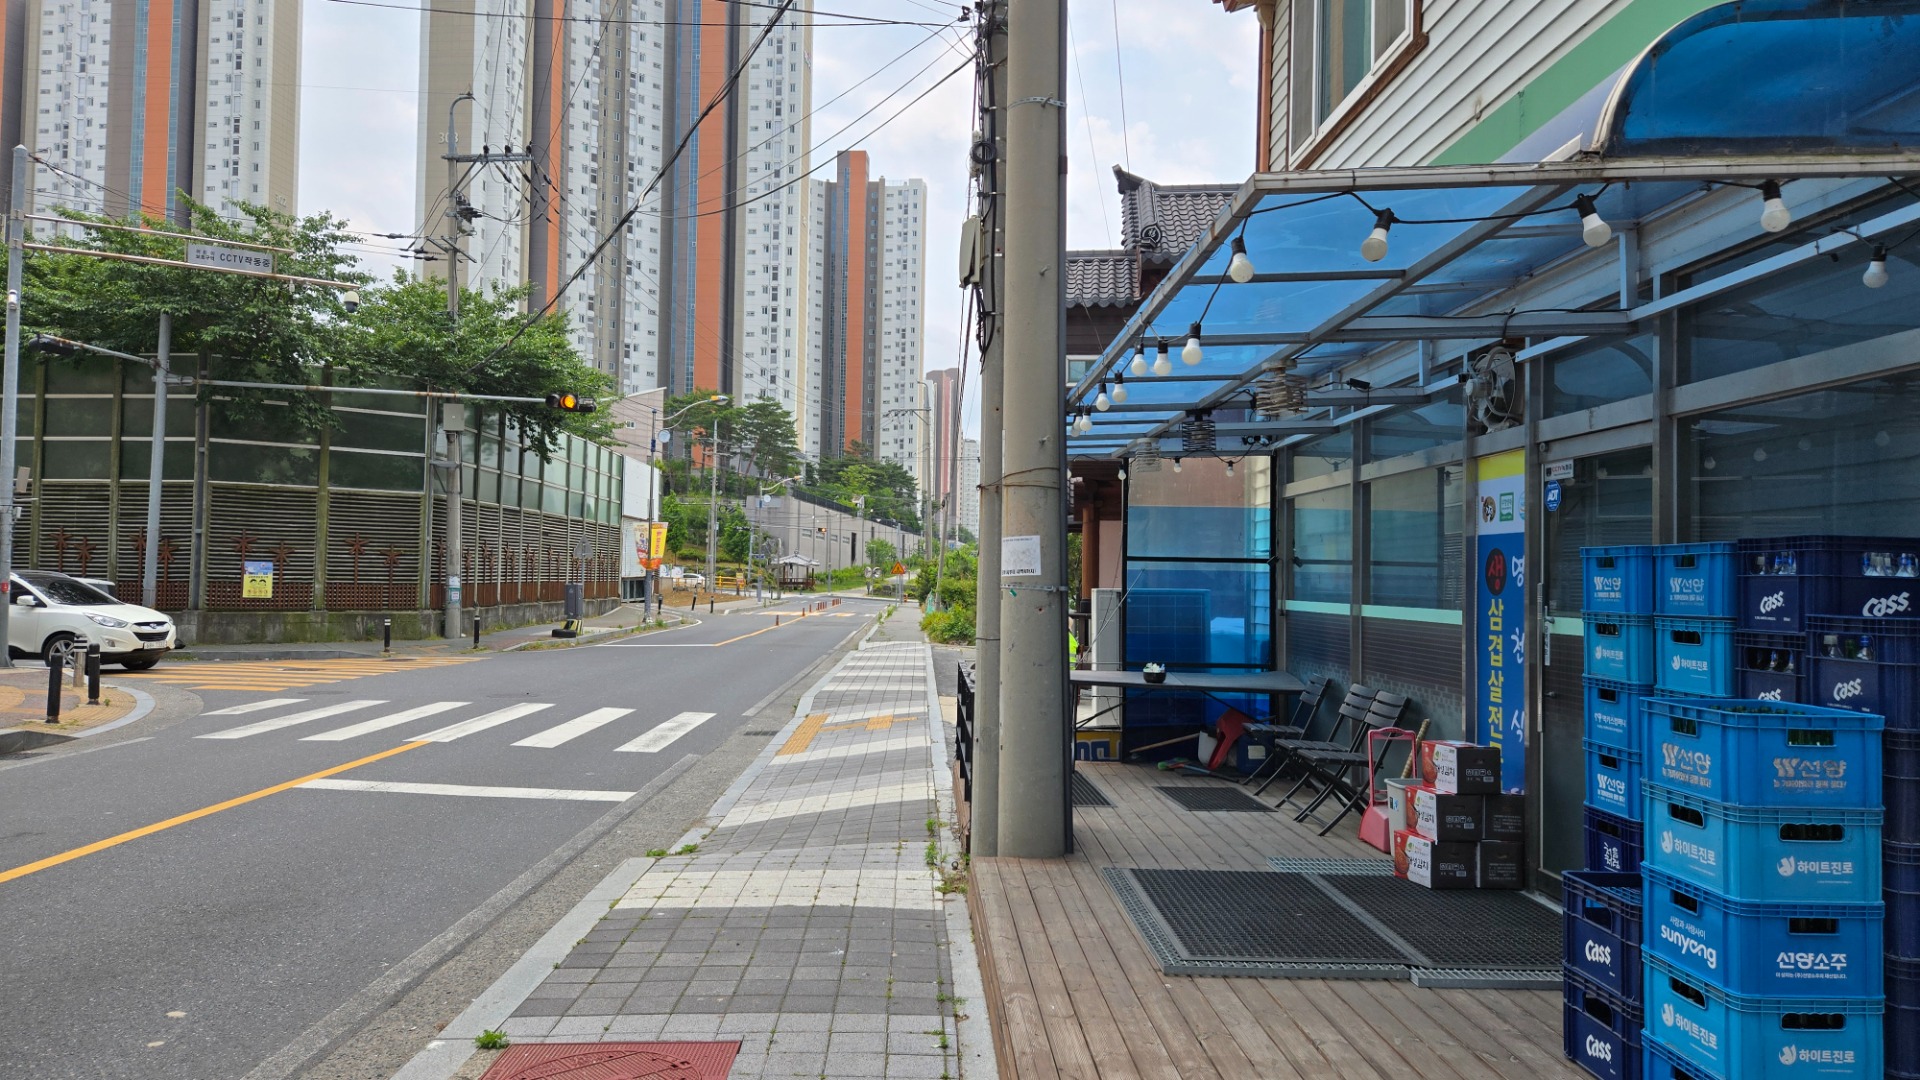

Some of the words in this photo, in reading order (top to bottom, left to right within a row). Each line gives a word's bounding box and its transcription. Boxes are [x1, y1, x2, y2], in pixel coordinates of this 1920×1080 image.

[219, 252, 271, 268] CCTV작동중
[1759, 590, 1784, 614] Cass
[1862, 591, 1912, 617] Cass
[1602, 648, 1624, 660] 하이트진로
[1681, 658, 1708, 671] 하이트진로
[1833, 678, 1863, 702] Cass
[1674, 838, 1716, 866] 하이트진로
[1797, 860, 1854, 875] 하이트진로
[1669, 915, 1685, 930] 사람과
[1584, 939, 1612, 966] Cass
[1776, 951, 1847, 971] 선양소주
[1675, 1014, 1718, 1050] 하이트진로
[1585, 1033, 1612, 1063] Cass
[1798, 1048, 1855, 1064] 하이트진로
